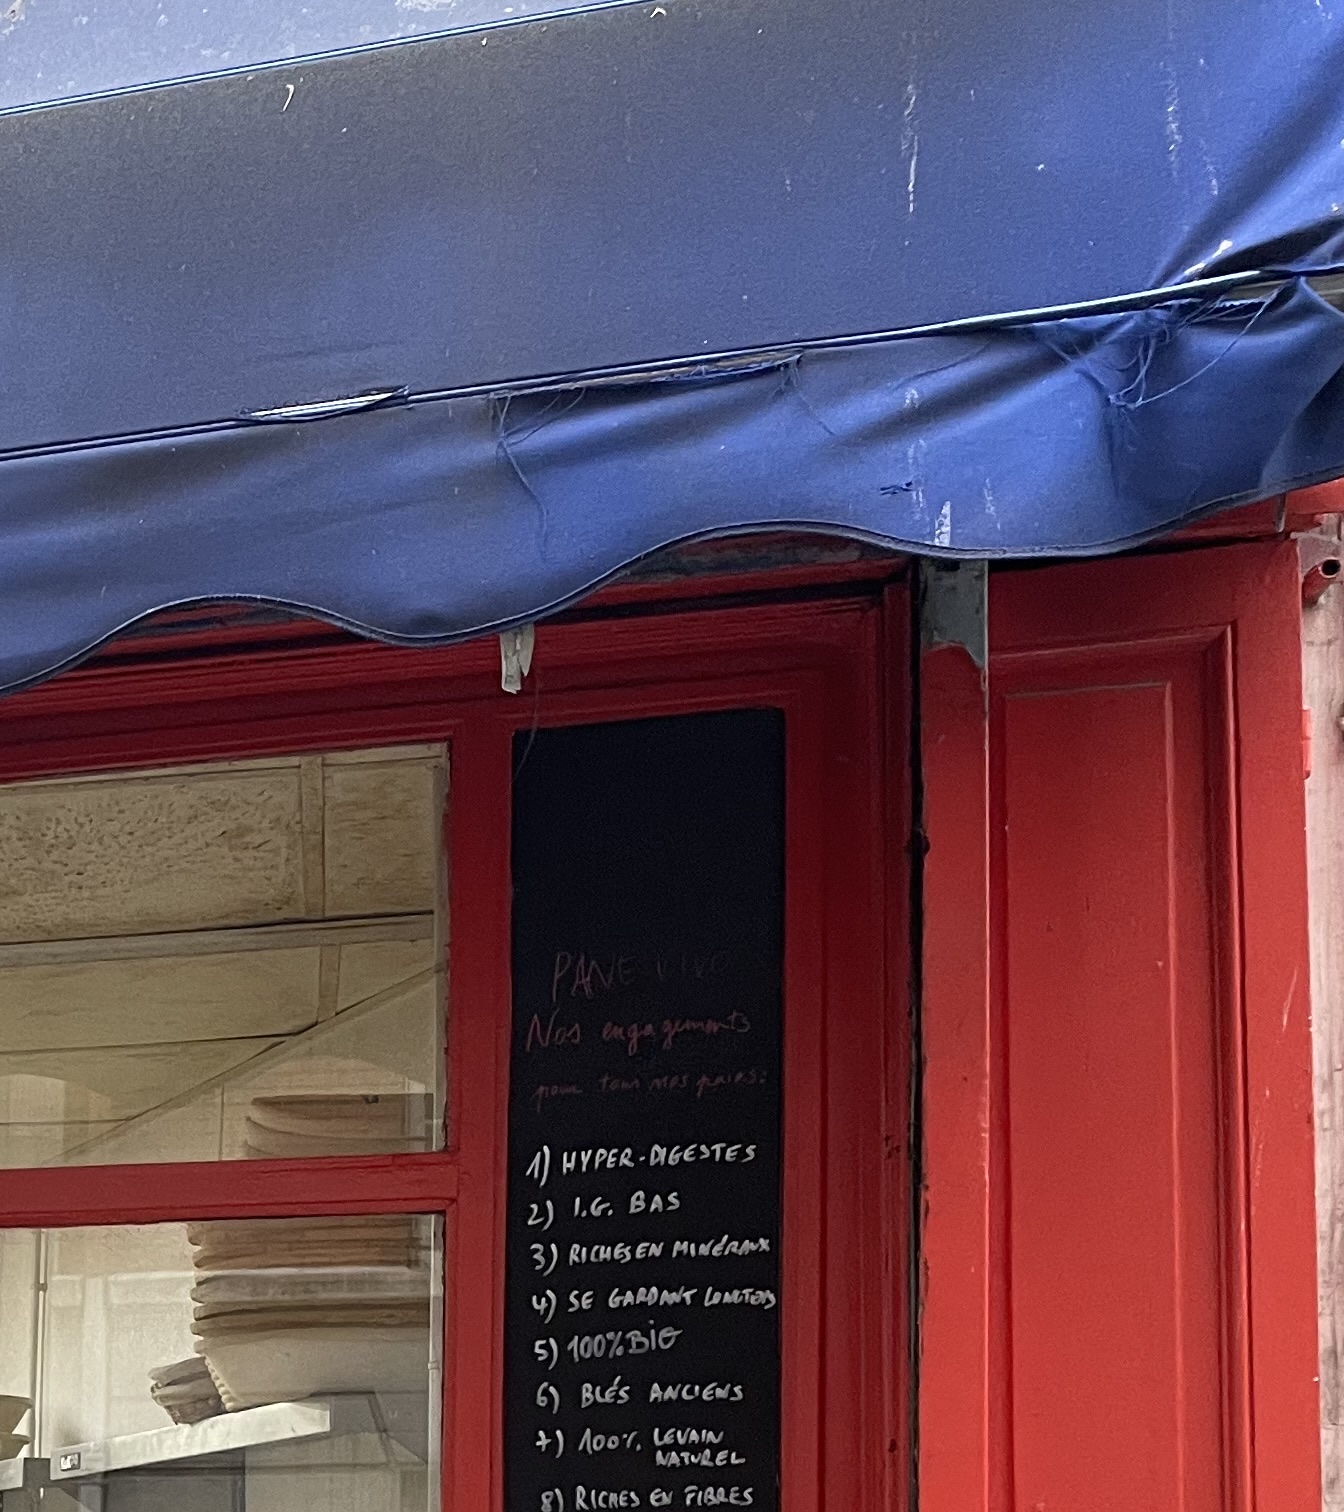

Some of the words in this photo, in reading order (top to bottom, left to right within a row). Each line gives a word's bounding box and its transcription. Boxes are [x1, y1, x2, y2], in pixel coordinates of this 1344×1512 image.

[526, 1008, 581, 1052] Nos
[562, 1143, 757, 1175] HYPER-DIGESTES
[527, 1200, 554, 1231] 2)
[628, 1190, 681, 1214] BAS
[529, 1243, 558, 1277] 3)
[569, 1244, 632, 1266] RICHES
[635, 1241, 663, 1258] EN
[532, 1289, 557, 1324] 4)
[567, 1290, 594, 1313] SE
[534, 1337, 558, 1370] 5)
[536, 1381, 559, 1415] 6)
[581, 1375, 631, 1408] BLÉS
[649, 1382, 744, 1403] ANCIENS
[653, 1428, 724, 1447] LEVAIN
[655, 1450, 746, 1467] NATUREL
[575, 1486, 641, 1511] RICHES
[684, 1486, 755, 1507] FIBRES
